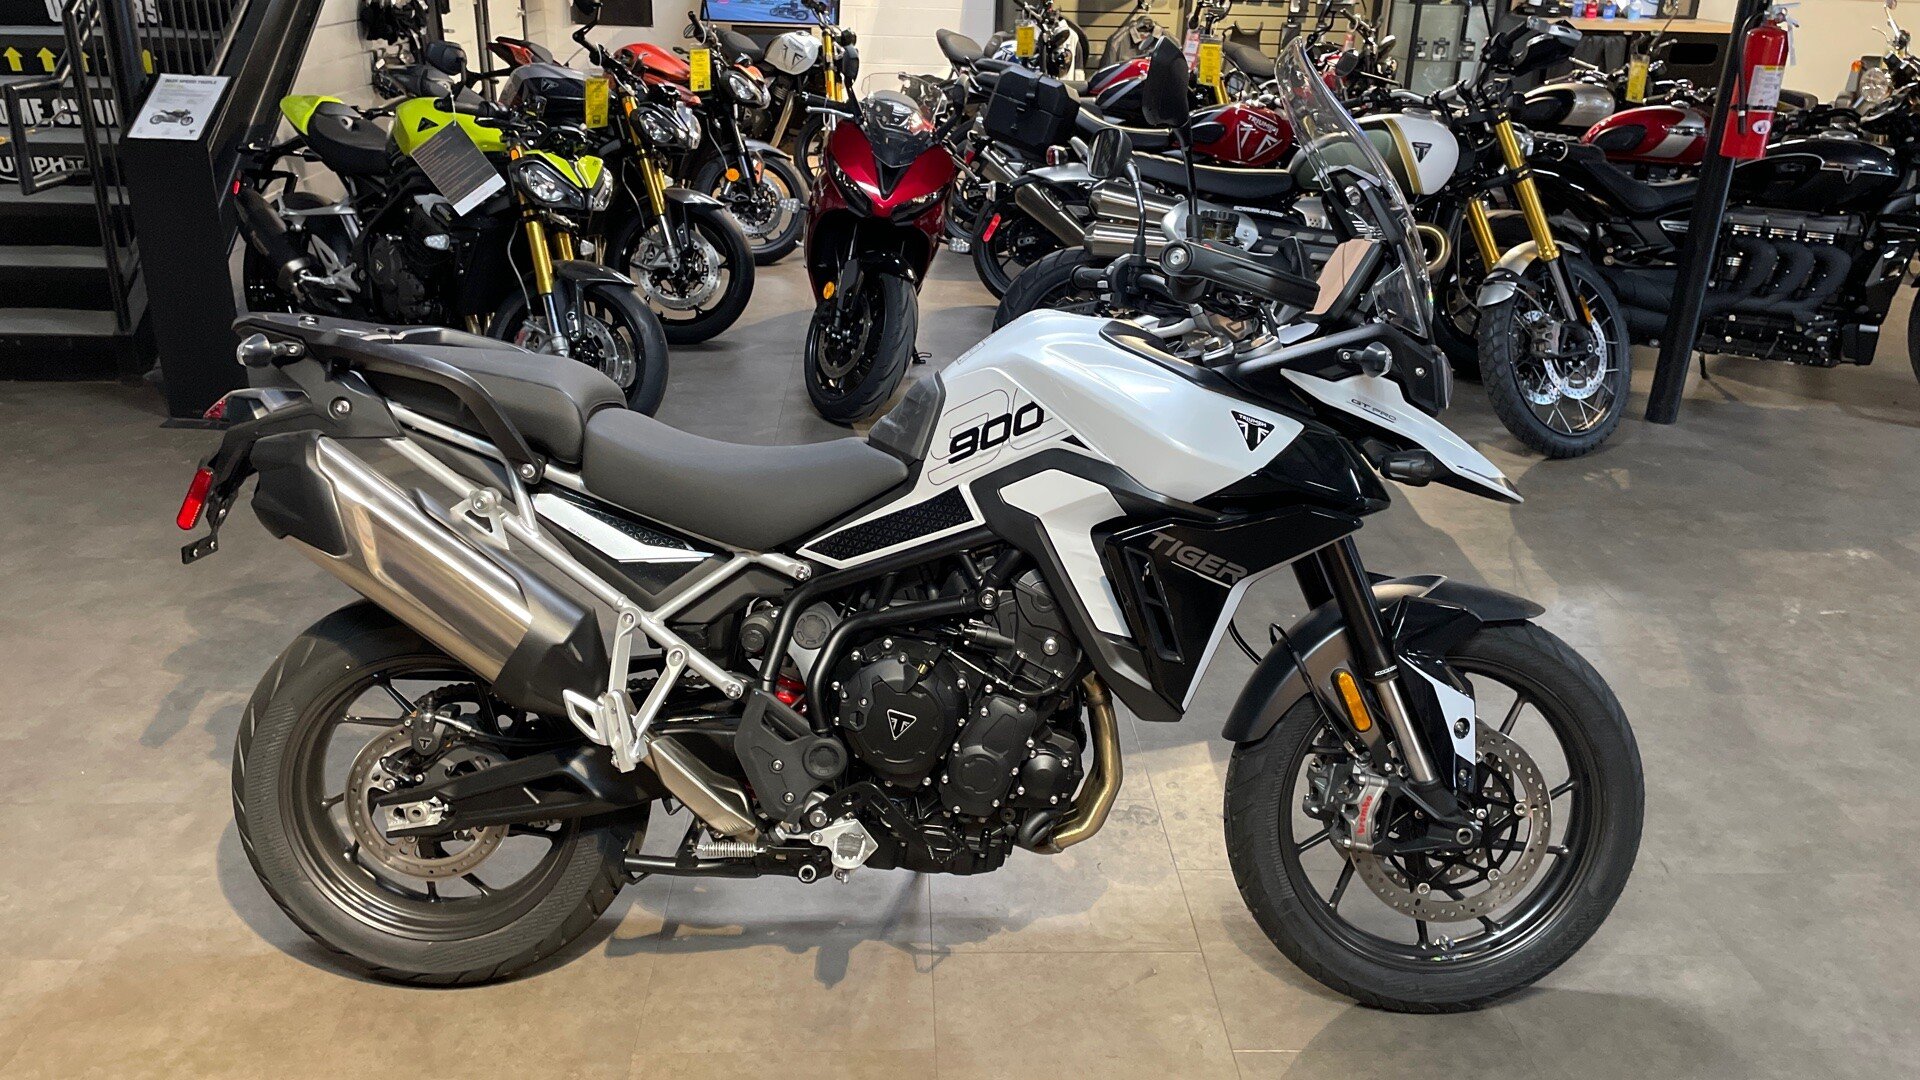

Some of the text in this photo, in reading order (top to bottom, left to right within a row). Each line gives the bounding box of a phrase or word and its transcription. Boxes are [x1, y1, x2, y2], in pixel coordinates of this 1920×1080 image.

[1247, 114, 1279, 136] TRIUMPH
[1238, 413, 1268, 428] TRIUMPH
[1351, 398, 1397, 421] GT PRO
[948, 400, 1045, 464] 900
[1148, 531, 1248, 584] TIGER
[1356, 794, 1374, 836] brembo
